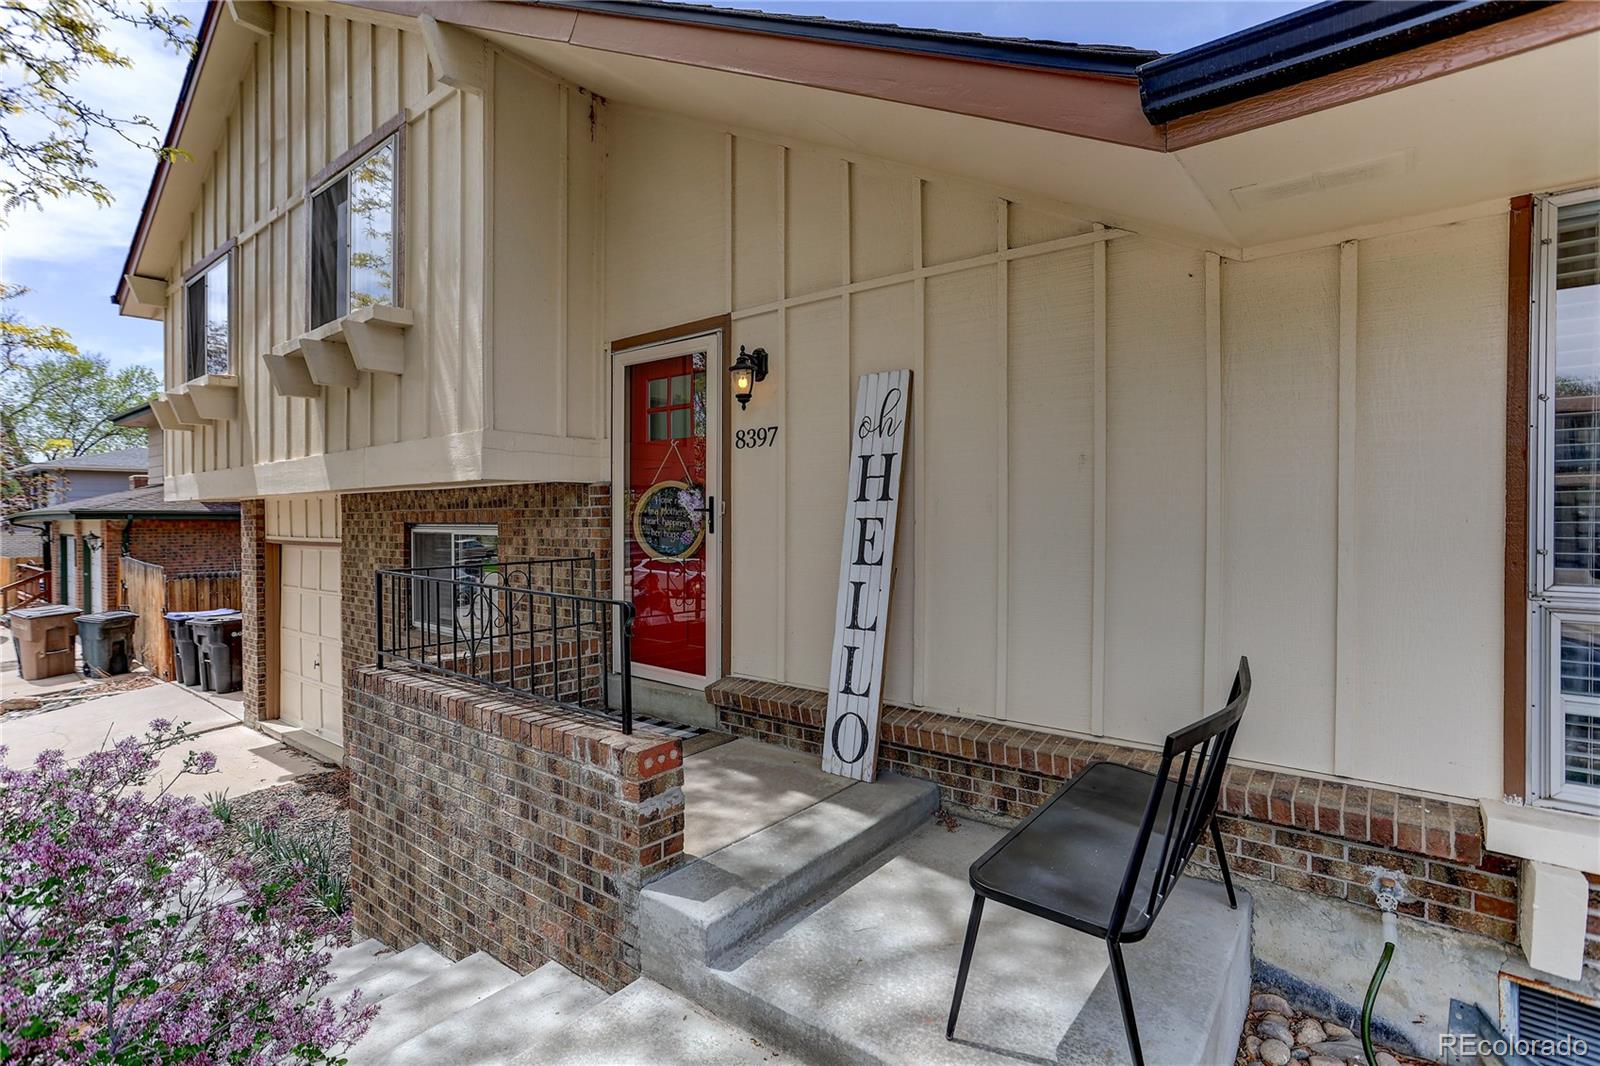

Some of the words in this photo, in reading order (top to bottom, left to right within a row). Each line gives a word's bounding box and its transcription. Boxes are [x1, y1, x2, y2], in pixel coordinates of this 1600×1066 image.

[735, 426, 778, 449] 8397
[859, 388, 902, 439] oh
[832, 453, 898, 764] HELLO
